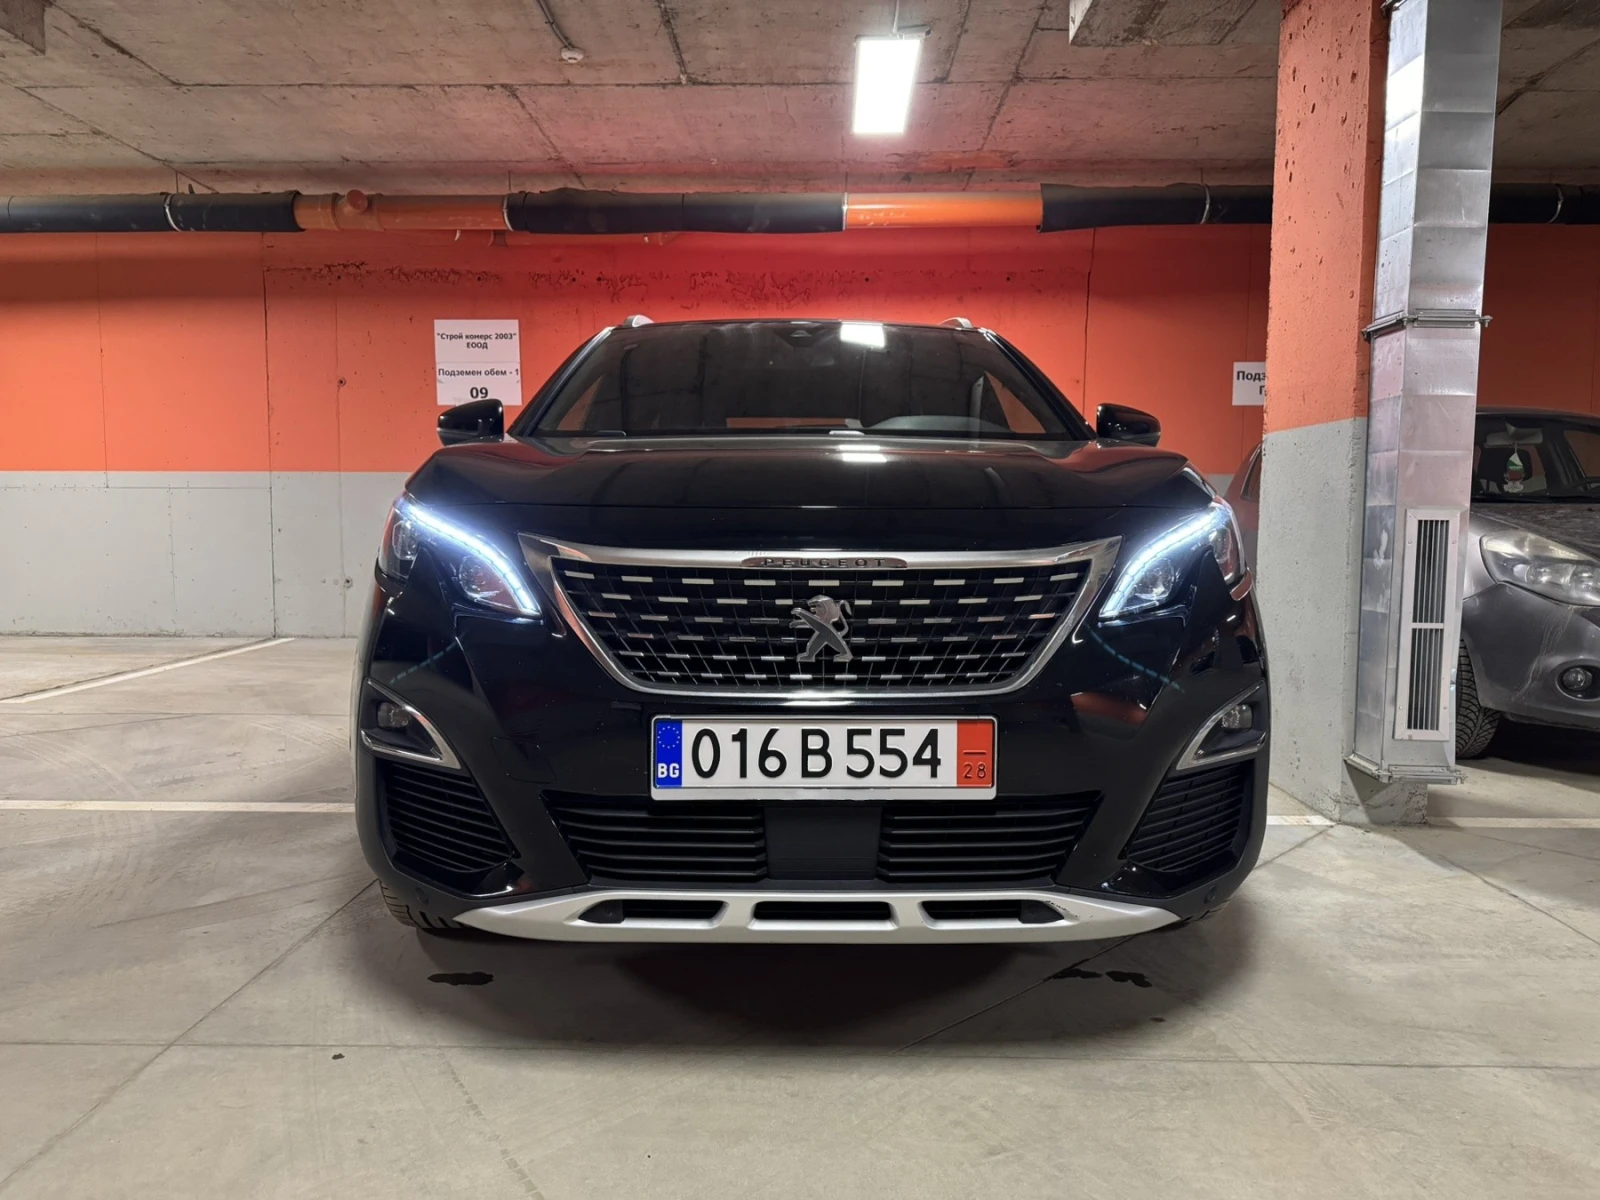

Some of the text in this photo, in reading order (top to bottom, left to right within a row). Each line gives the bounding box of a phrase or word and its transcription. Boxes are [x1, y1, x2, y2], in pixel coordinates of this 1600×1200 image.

[438, 368, 482, 377] Подземен
[484, 368, 507, 376] обем
[1236, 370, 1266, 382] Подз
[470, 386, 489, 399] 09
[763, 558, 886, 568] PEUGEOT
[657, 763, 680, 779] BG
[963, 761, 987, 779] 28
